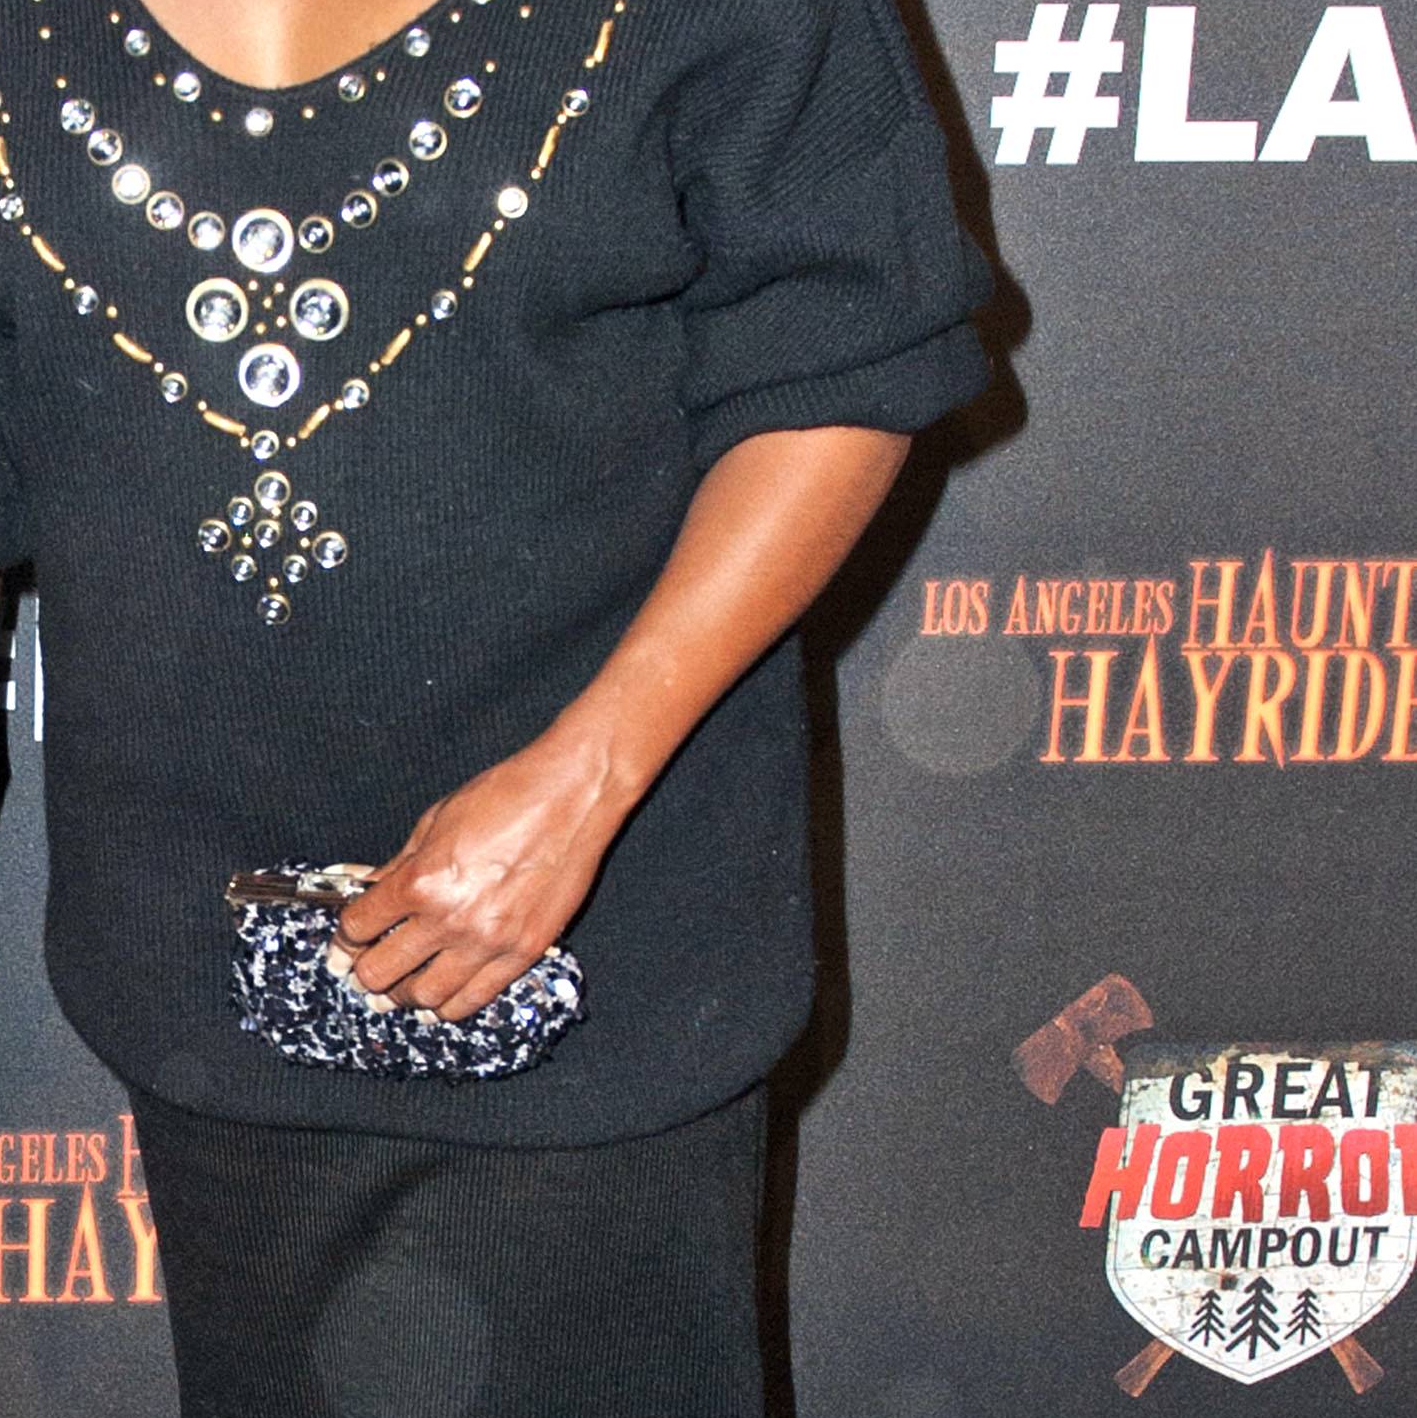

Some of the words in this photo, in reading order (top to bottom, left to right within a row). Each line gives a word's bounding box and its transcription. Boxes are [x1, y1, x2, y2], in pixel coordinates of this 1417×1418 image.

[920, 579, 990, 636] LOS
[1002, 574, 1176, 636] ANGELES
[1169, 1061, 1384, 1121] GREAT
[1140, 1226, 1389, 1270] CAMPOUT
